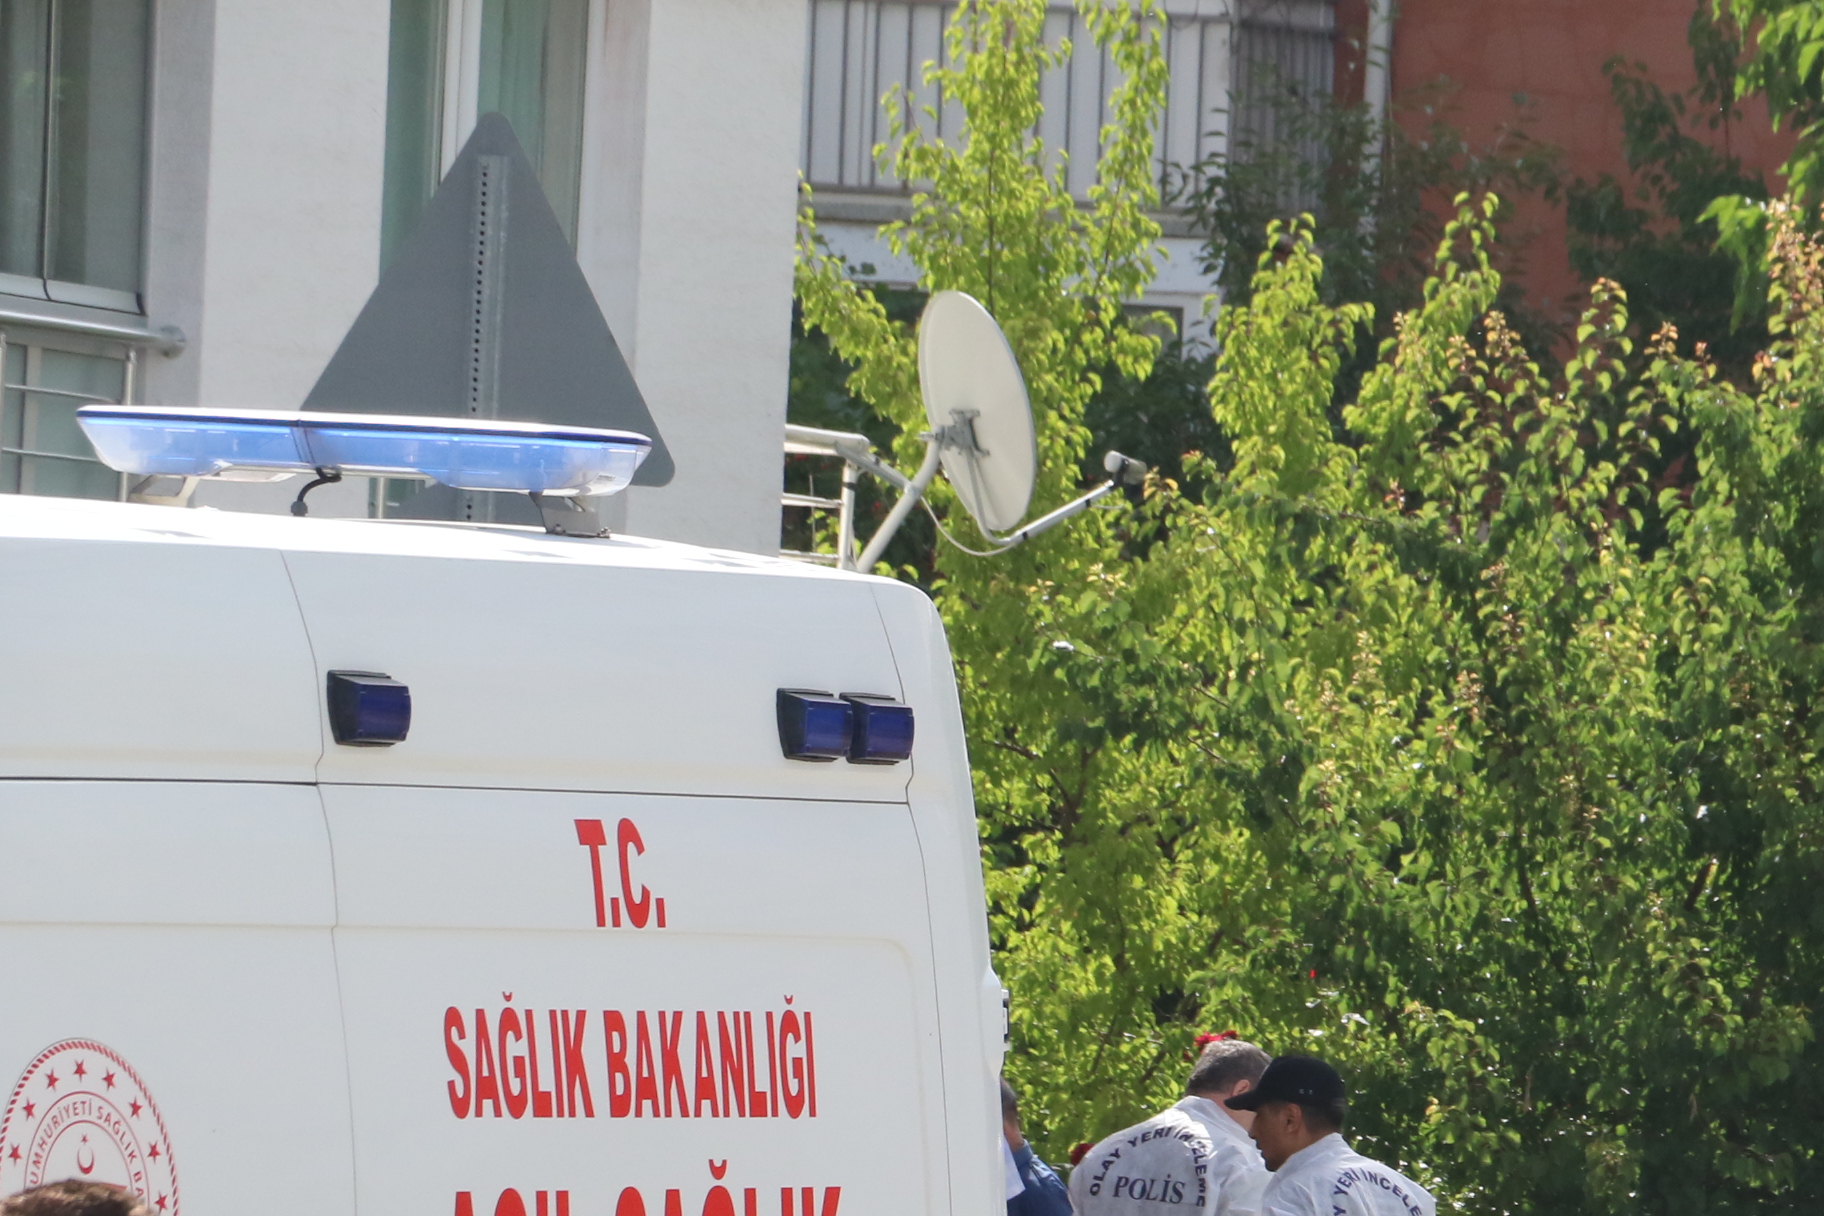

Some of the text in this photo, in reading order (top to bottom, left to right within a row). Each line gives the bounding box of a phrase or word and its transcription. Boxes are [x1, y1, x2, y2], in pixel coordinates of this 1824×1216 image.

[573, 817, 667, 929] T.C.
[443, 990, 818, 1120] SAĞLIK BAKANLIĞI
[1089, 1147, 1121, 1197] OLAY
[1113, 1173, 1186, 1205] POLİS
